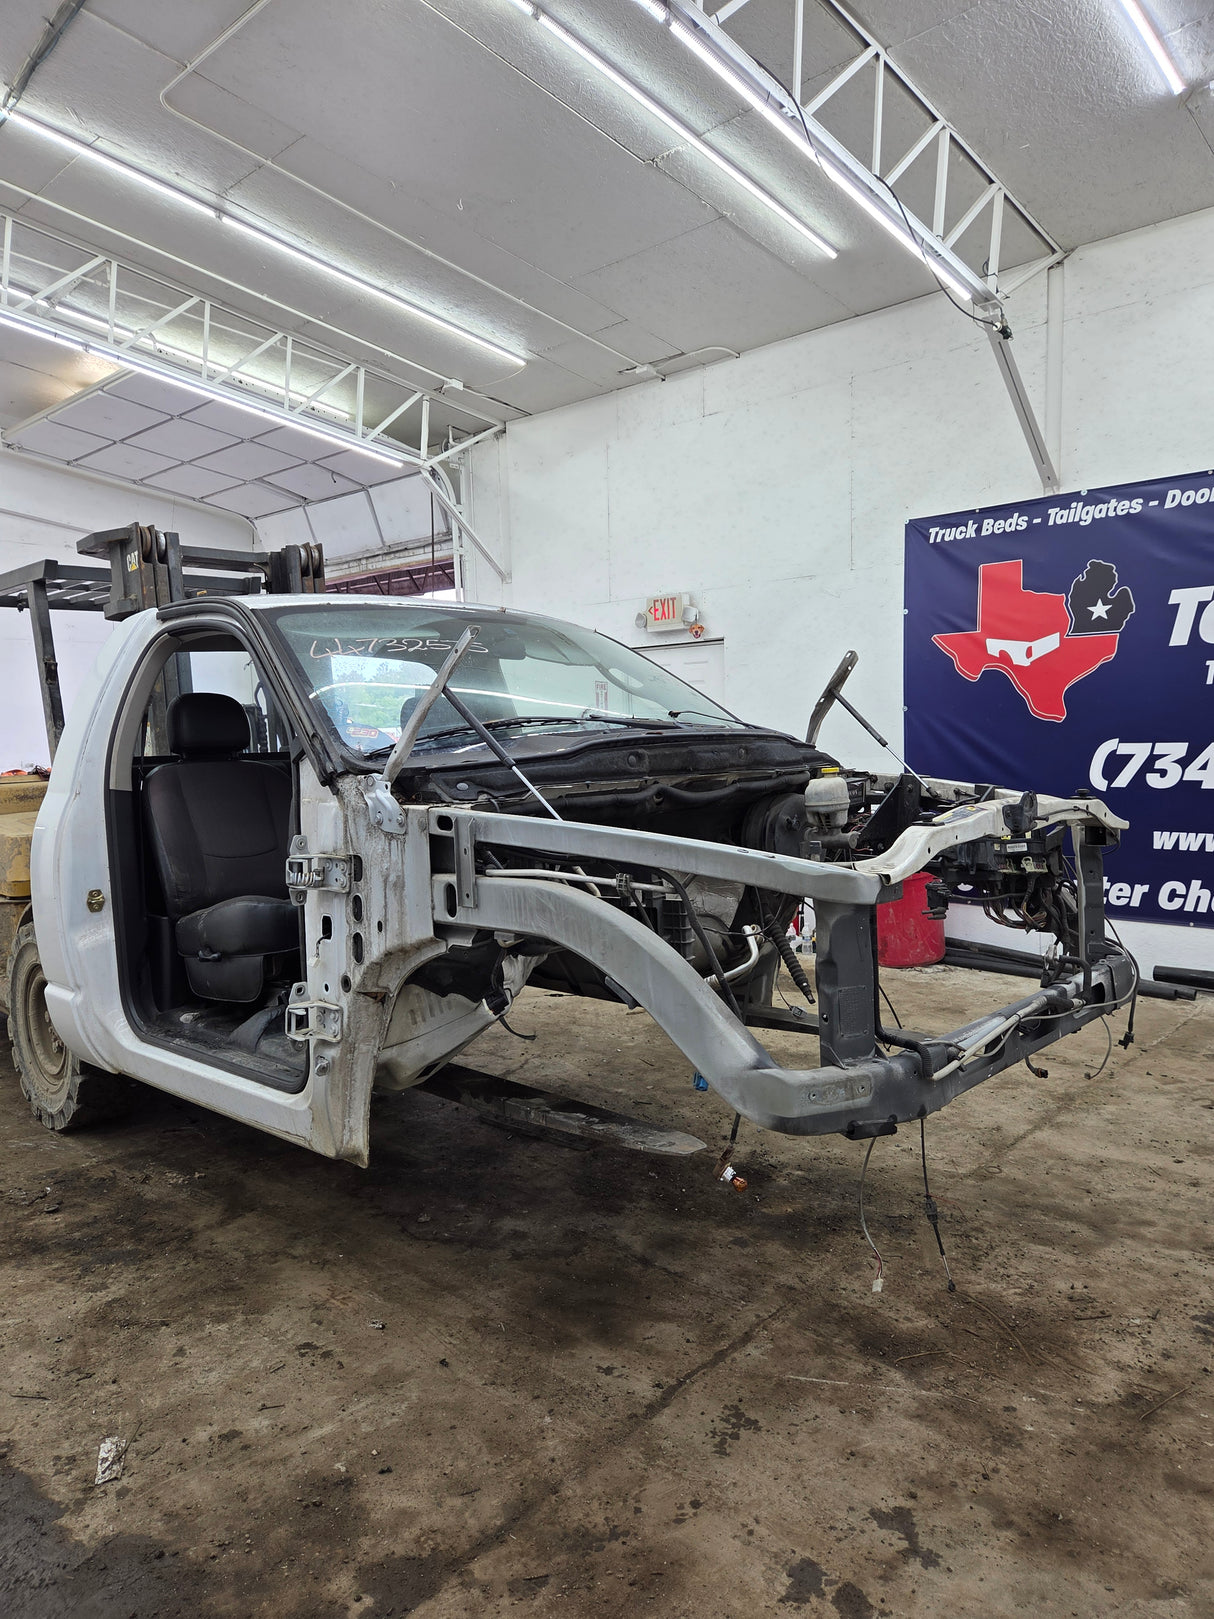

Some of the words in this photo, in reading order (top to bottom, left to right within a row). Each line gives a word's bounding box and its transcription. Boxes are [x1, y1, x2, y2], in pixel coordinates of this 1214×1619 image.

[928, 520, 978, 543] Truck
[981, 513, 1029, 536] Beds
[1047, 498, 1144, 526] Tailgates
[126, 550, 139, 572] CAT
[653, 597, 677, 621] EXIT
[1089, 738, 1214, 792] (734
[1158, 879, 1214, 913] Ch
